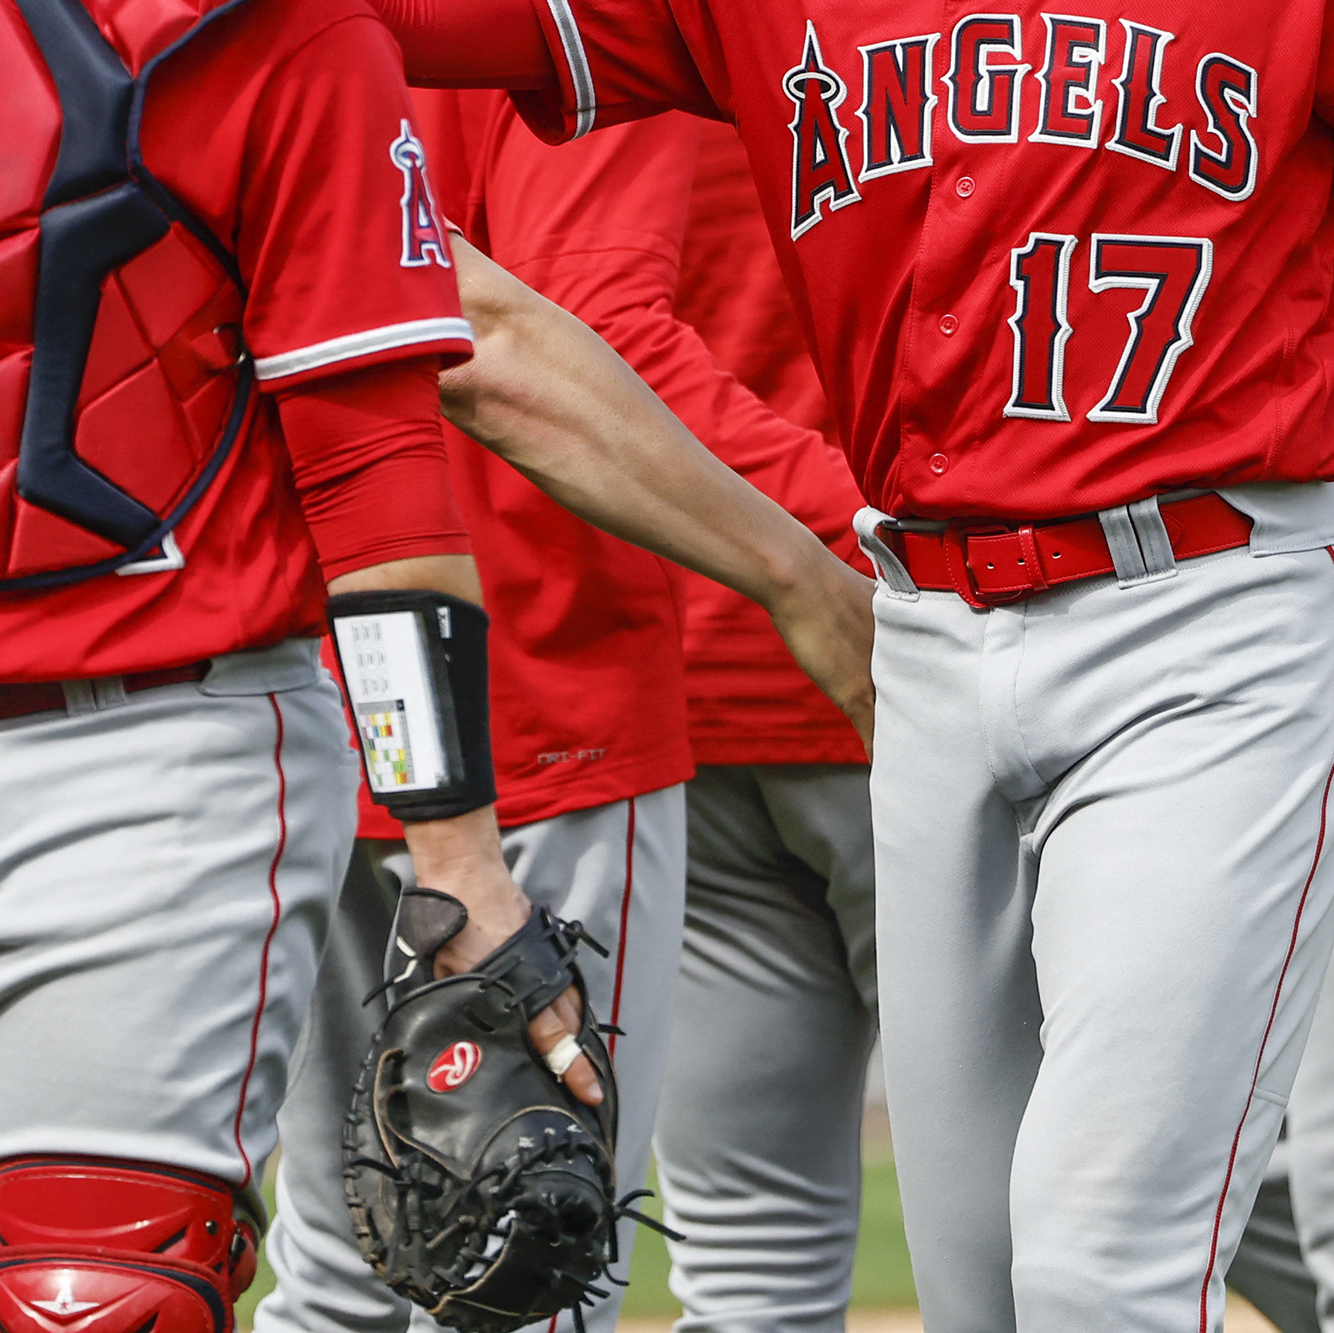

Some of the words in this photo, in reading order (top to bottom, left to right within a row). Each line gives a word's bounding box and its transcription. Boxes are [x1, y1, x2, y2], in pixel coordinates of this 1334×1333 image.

[389, 118, 451, 268] A
[782, 14, 1258, 241] ANGELS
[1004, 233, 1213, 423] 17
[538, 749, 605, 764] DRI-FIT
